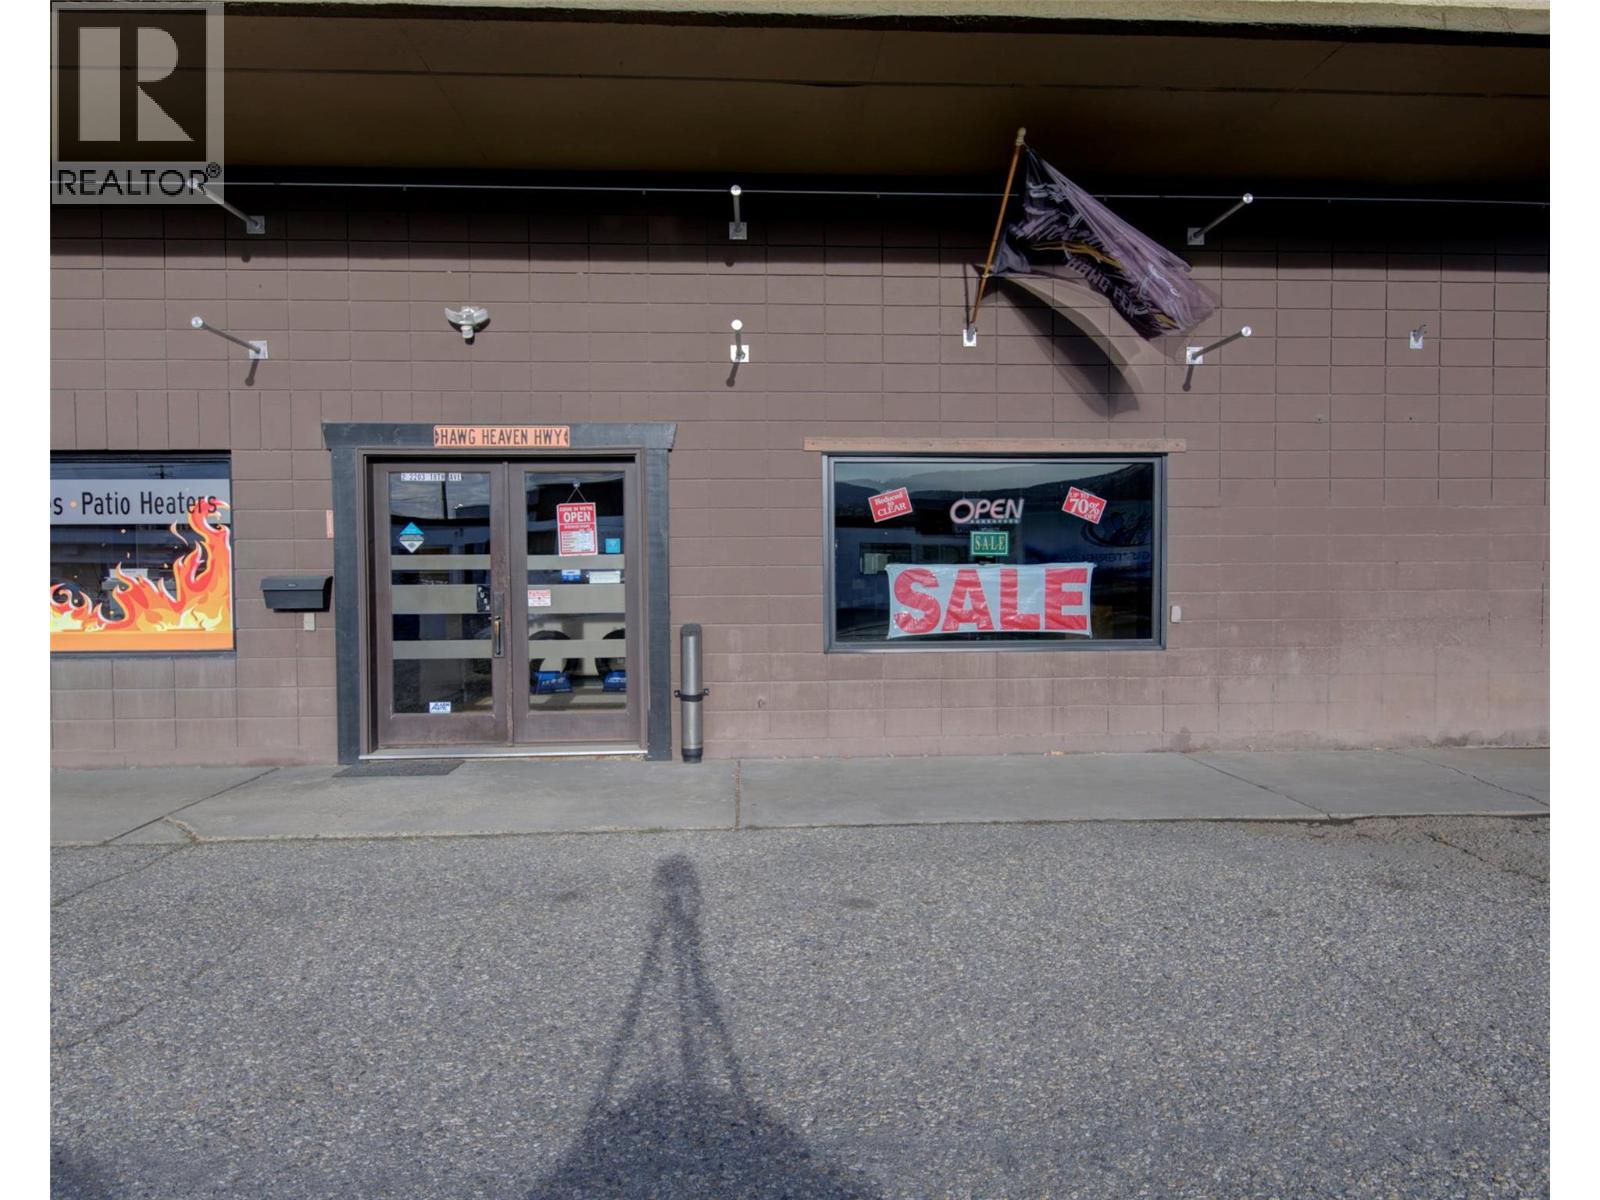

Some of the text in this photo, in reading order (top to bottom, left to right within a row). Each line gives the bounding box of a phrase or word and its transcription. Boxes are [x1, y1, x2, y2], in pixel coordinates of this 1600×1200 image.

[440, 428, 562, 445] HAWG HEAVEN HWY
[81, 491, 131, 516] Patio
[140, 491, 217, 515] Heaters
[878, 503, 906, 516] CLEAR
[949, 497, 1025, 524] OPEN
[1069, 498, 1101, 515] 70%
[563, 511, 591, 522] OPEN
[893, 568, 1088, 633] SALE
